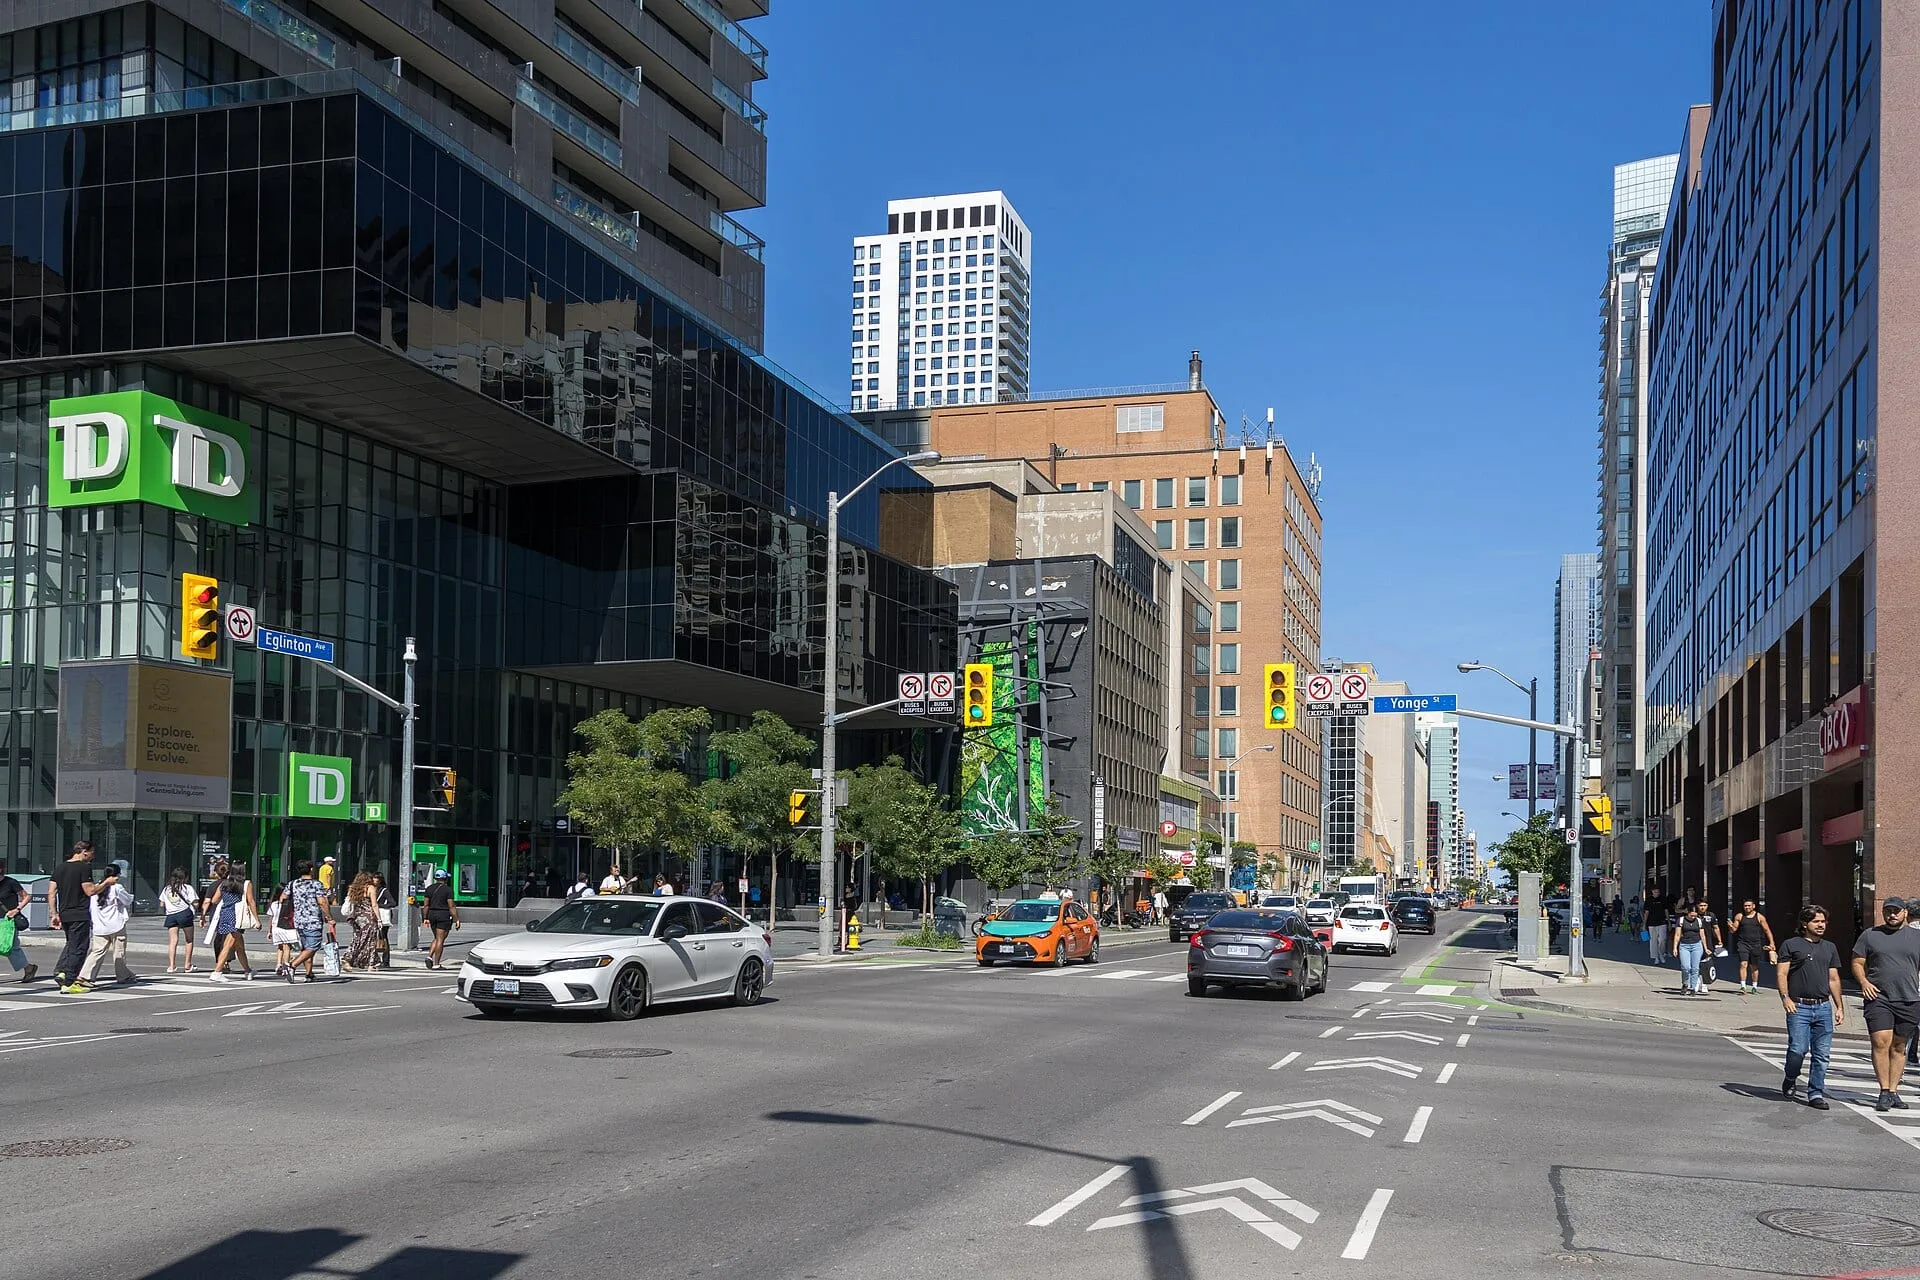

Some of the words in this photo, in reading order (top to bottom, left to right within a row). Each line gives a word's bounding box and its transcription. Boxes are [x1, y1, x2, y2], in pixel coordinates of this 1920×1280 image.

[49, 412, 130, 480] TD
[154, 414, 245, 497] TD
[265, 632, 311, 654] Eglinton
[315, 642, 326, 651] Ave
[1390, 697, 1429, 711] Yonge
[147, 723, 195, 739] Explore.
[1819, 709, 1839, 756] CIBC
[147, 736, 200, 753] Discover.
[146, 750, 188, 764] Evolve.
[299, 765, 345, 806] TD
[366, 806, 381, 818] TD
